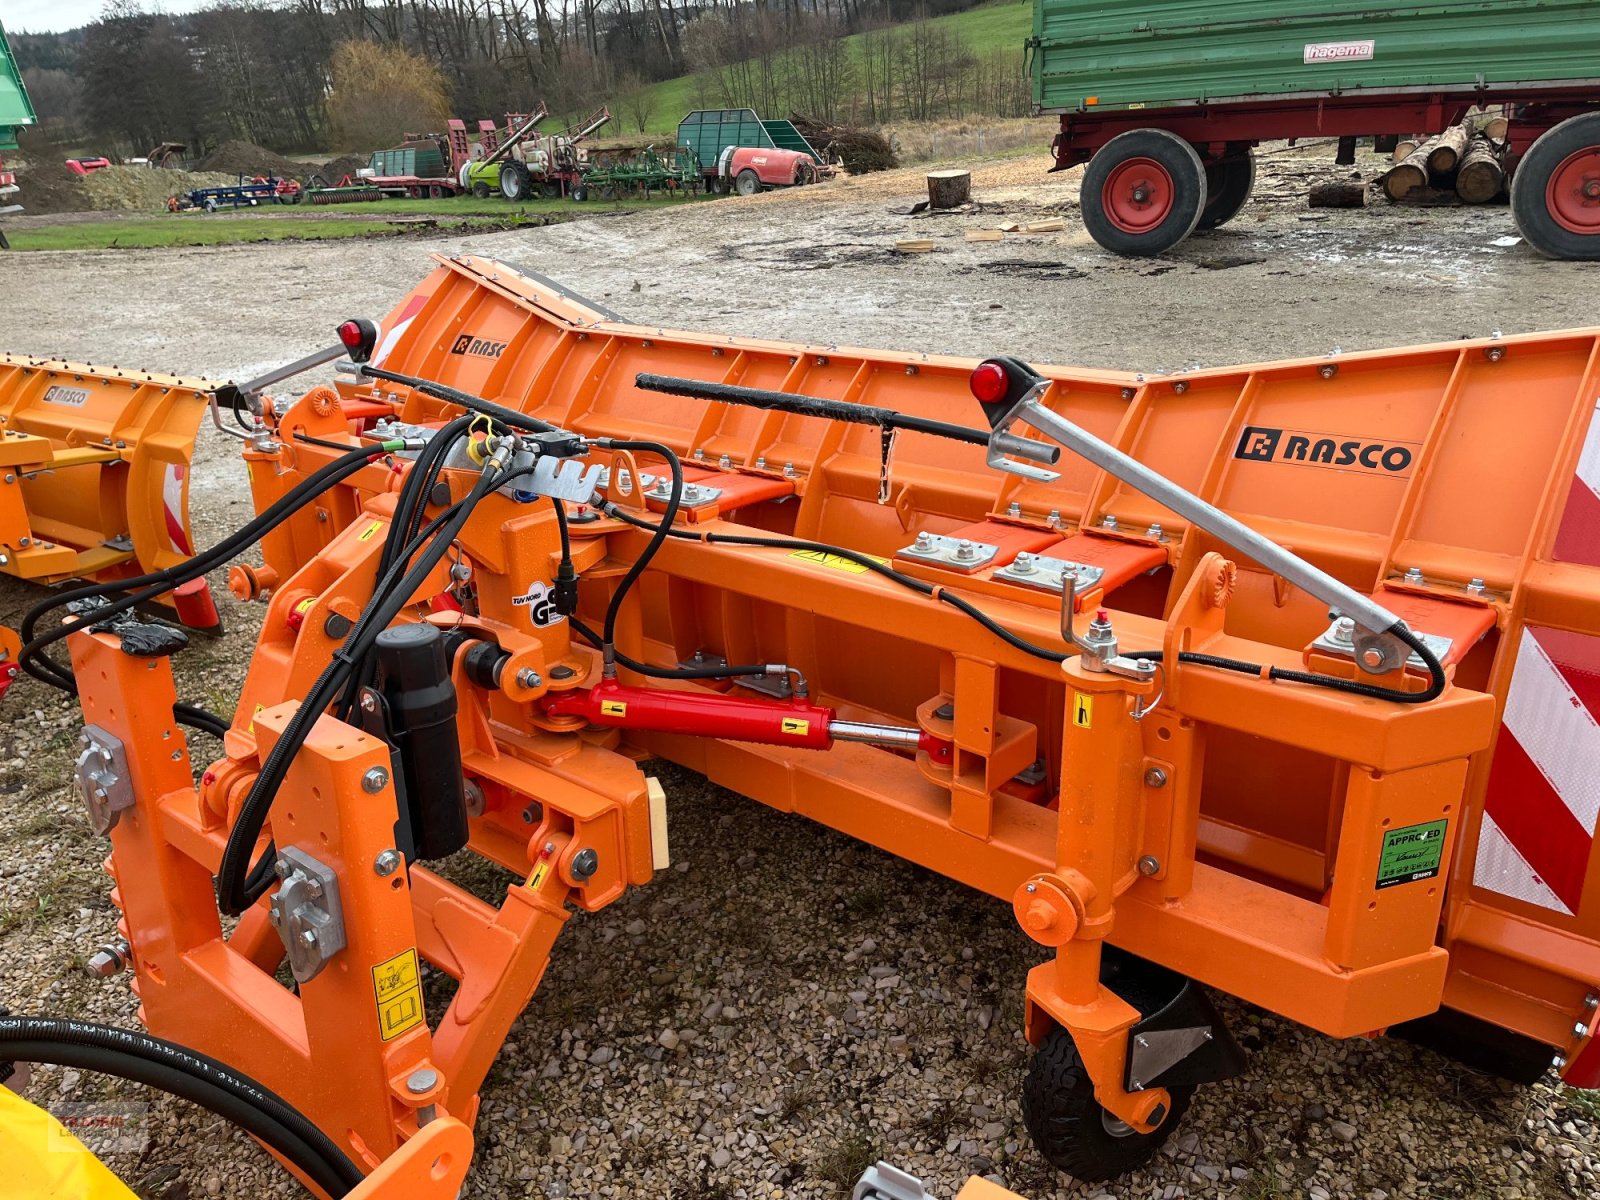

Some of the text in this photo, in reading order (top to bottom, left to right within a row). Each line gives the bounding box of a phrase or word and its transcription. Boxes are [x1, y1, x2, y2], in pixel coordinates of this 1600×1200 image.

[1310, 45, 1369, 60] hagema
[469, 339, 507, 358] RASC
[55, 389, 86, 403] RASCO
[1283, 435, 1412, 472] RASCO
